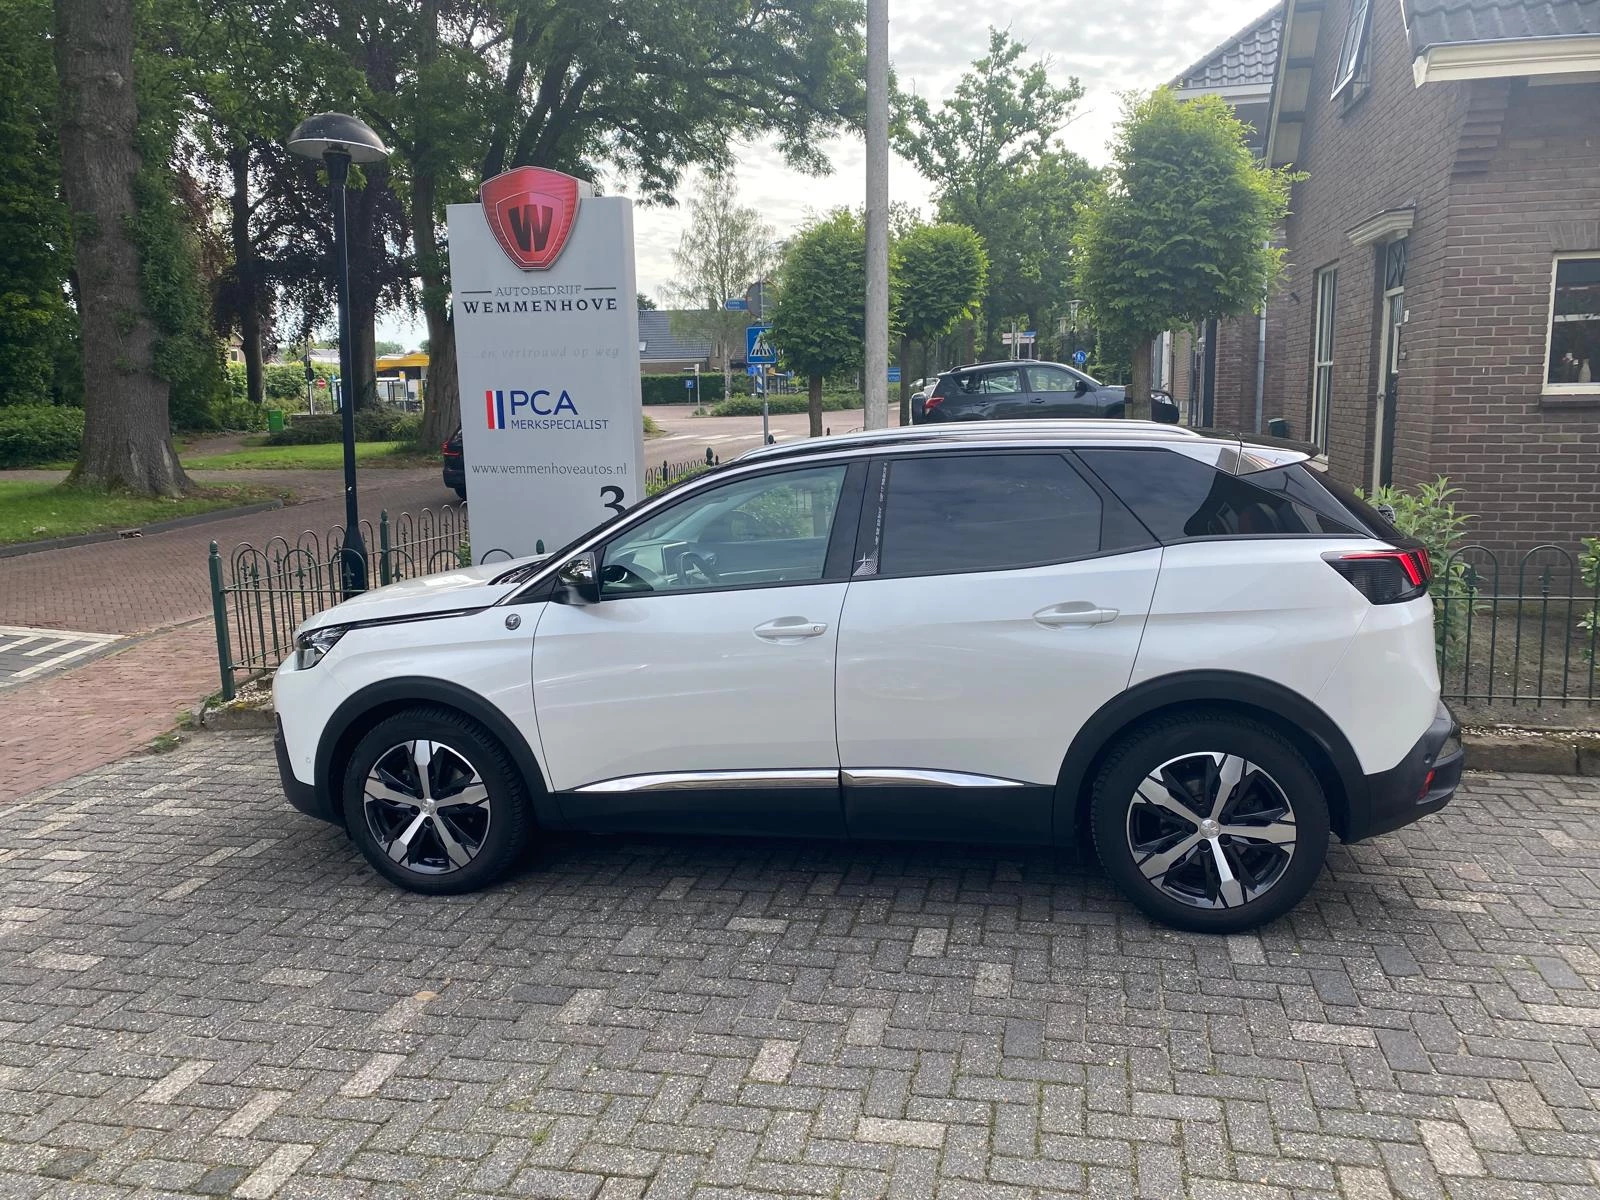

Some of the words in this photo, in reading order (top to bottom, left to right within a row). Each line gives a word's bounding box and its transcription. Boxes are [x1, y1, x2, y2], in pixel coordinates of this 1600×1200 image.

[508, 204, 554, 252] W
[494, 284, 582, 297] AUTOBEDRIJF
[462, 298, 618, 314] WEMMENHOVE
[480, 348, 496, 359] en
[595, 346, 620, 359] weg
[509, 389, 579, 416] PCA
[511, 419, 609, 430] MERKSPECIALIST
[471, 462, 628, 475] www.wemmenhoveautos.nl
[599, 485, 627, 519] 3
